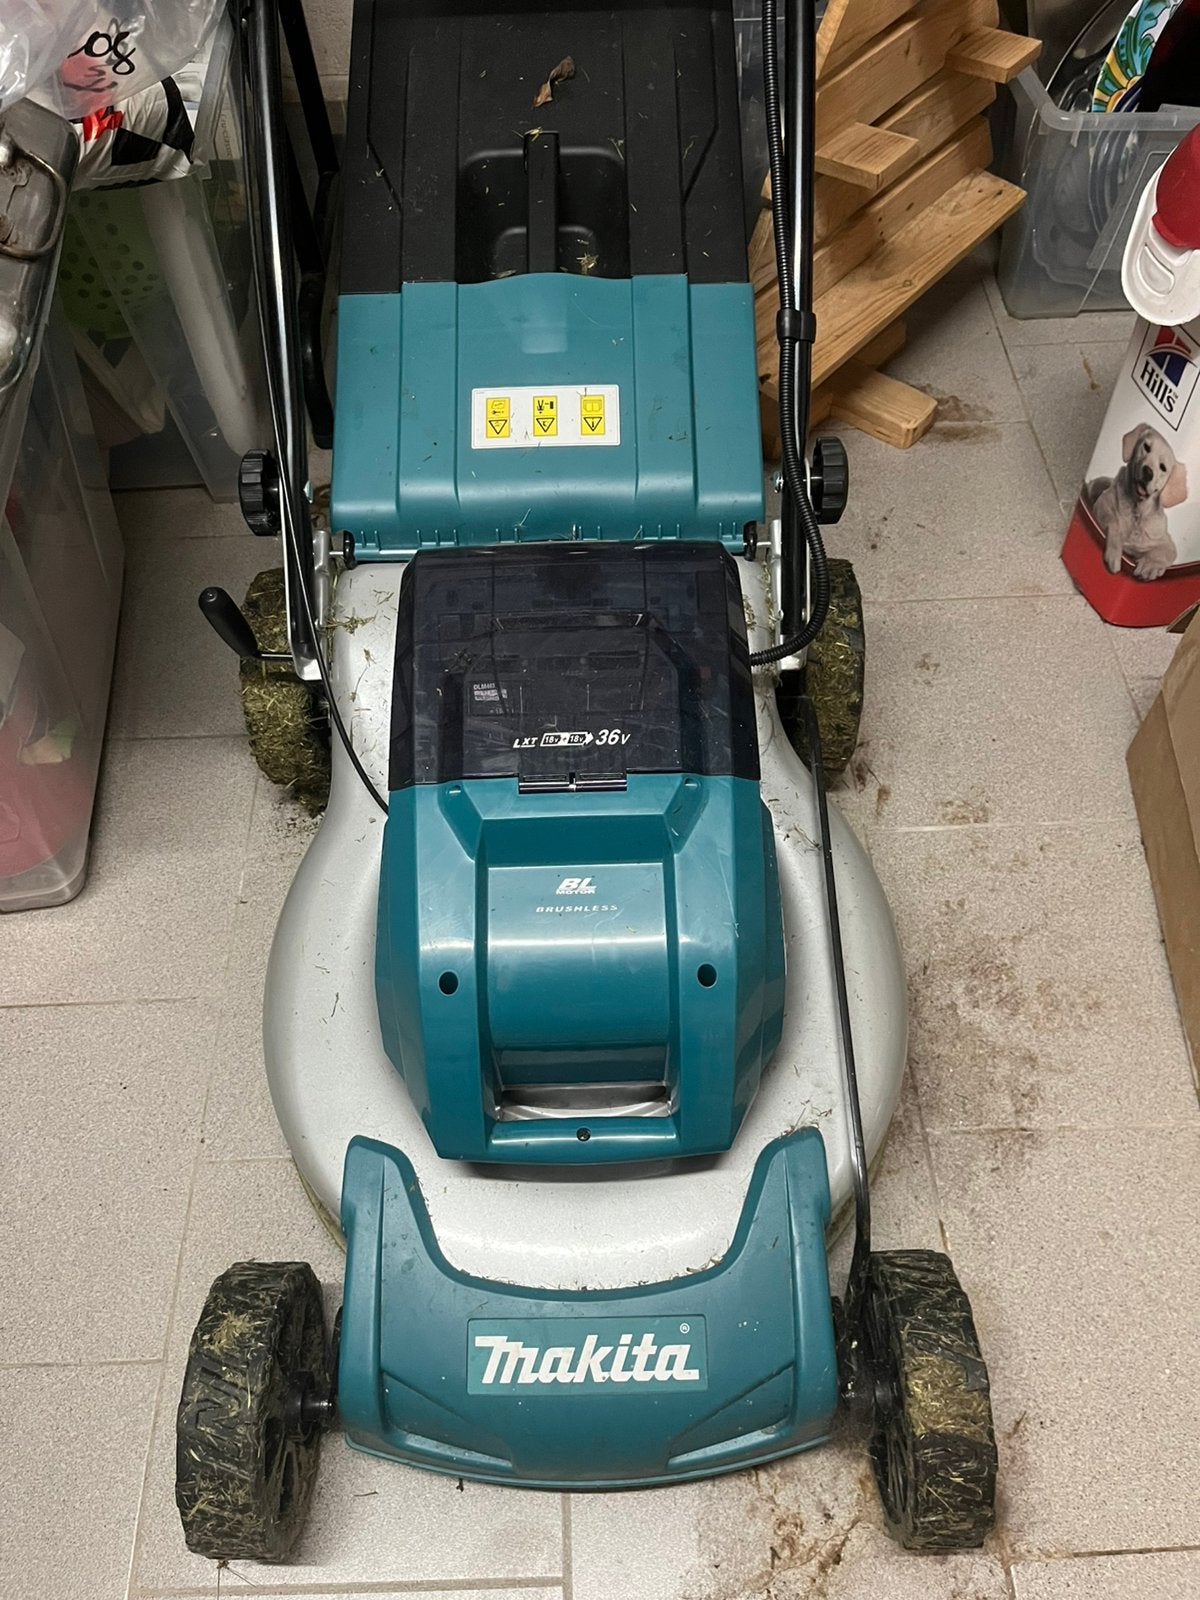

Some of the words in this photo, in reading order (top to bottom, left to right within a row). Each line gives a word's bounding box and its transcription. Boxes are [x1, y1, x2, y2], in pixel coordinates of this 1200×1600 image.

[1140, 360, 1174, 413] Hill's
[512, 737, 538, 748] LXT
[559, 877, 597, 891] BL
[535, 904, 618, 913] BRUSHLESS
[475, 1333, 700, 1384] Makita
